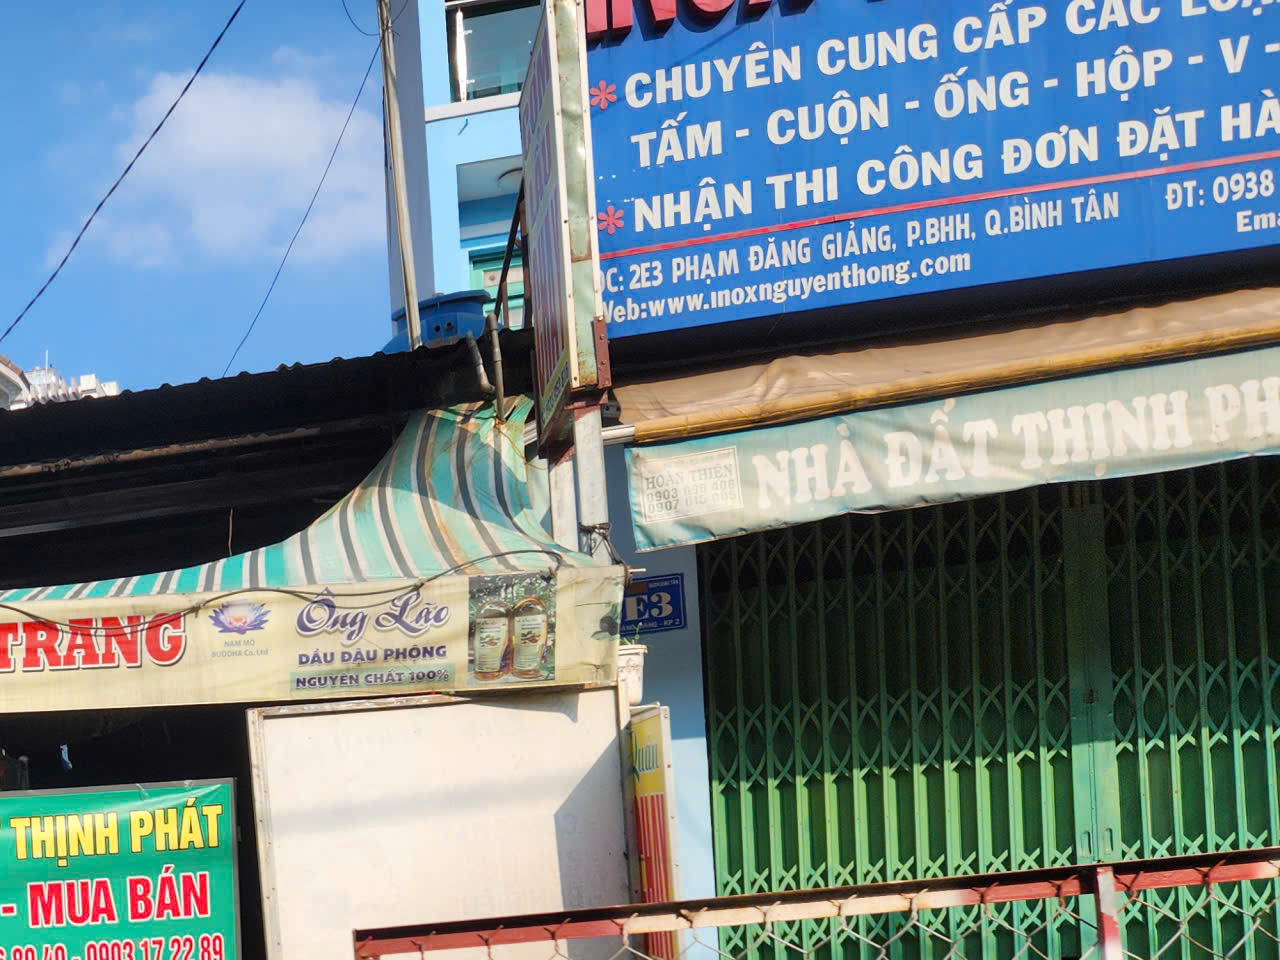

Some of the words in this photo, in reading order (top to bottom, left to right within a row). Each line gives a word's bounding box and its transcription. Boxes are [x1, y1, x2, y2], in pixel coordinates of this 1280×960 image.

[624, 41, 801, 108] CHUYÊN
[817, 24, 938, 75] CUNG
[953, 0, 1047, 53] CẤP
[631, 111, 723, 168] TẤM
[767, 90, 889, 145] CUỘN
[934, 66, 1029, 118] ỐNG
[1076, 45, 1173, 101] HỘP
[1219, 35, 1250, 74] V
[634, 176, 752, 232] NHẬN
[765, 166, 838, 210] THI
[856, 144, 983, 195] CÔNG
[1001, 124, 1099, 175] ĐƠN
[1116, 106, 1205, 162] ĐẶT
[1165, 180, 1205, 211] ĐT:
[1212, 169, 1275, 204] 0938
[629, 261, 663, 290] 2E3
[672, 248, 740, 285] PHẠM
[748, 237, 811, 272] ĐĂNG
[822, 221, 897, 261] GIẢNG,
[907, 212, 977, 248] P.BHH,
[984, 197, 1063, 237] Q.BÌNH
[1071, 188, 1119, 224] TÂN
[752, 424, 872, 509] NHÀ
[884, 398, 999, 488] ĐẤT
[1012, 390, 1192, 477] THỊNH
[296, 672, 359, 688] NGUYÊN
[364, 669, 404, 685] CHẤT
[409, 668, 449, 683] 100%
[298, 648, 334, 666] DẦU
[341, 649, 377, 667] ĐẬU
[384, 645, 447, 665] PHỘNG
[10, 811, 119, 867] THỊNH
[130, 797, 223, 853] PHÁT
[28, 878, 118, 928] MUA
[127, 865, 211, 922] BÁN
